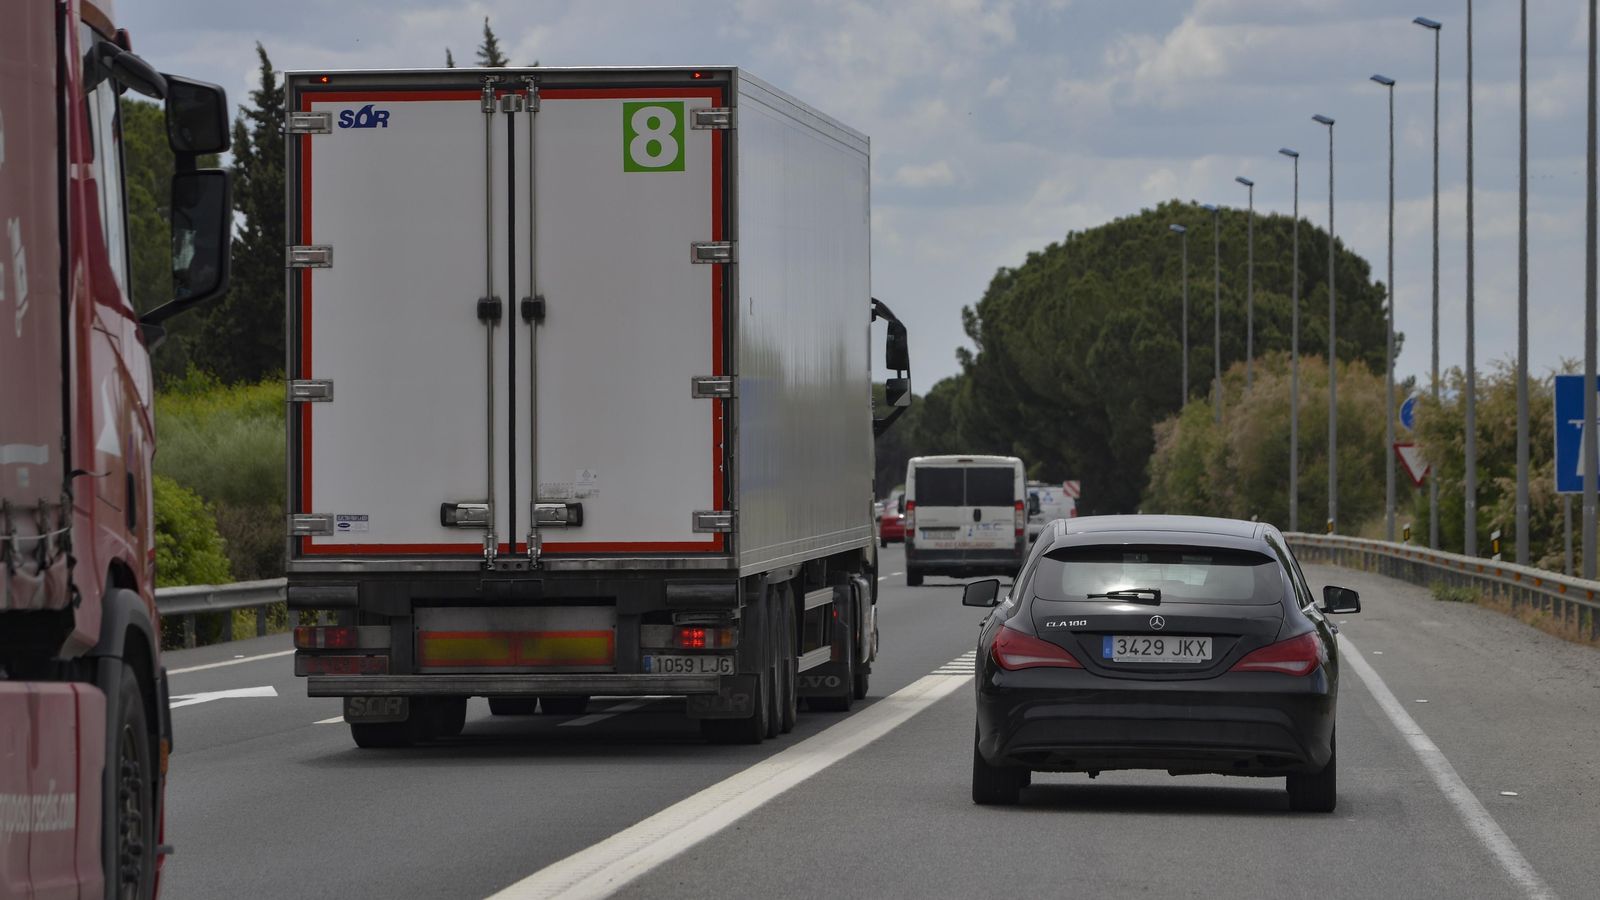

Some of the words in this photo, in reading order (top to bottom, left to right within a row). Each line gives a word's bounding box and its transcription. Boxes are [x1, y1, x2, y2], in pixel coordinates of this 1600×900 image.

[629, 106, 679, 168] 8
[1117, 639, 1164, 656] 3429
[1172, 640, 1207, 656] JKX
[657, 658, 694, 673] 1059
[700, 658, 730, 673] LJG
